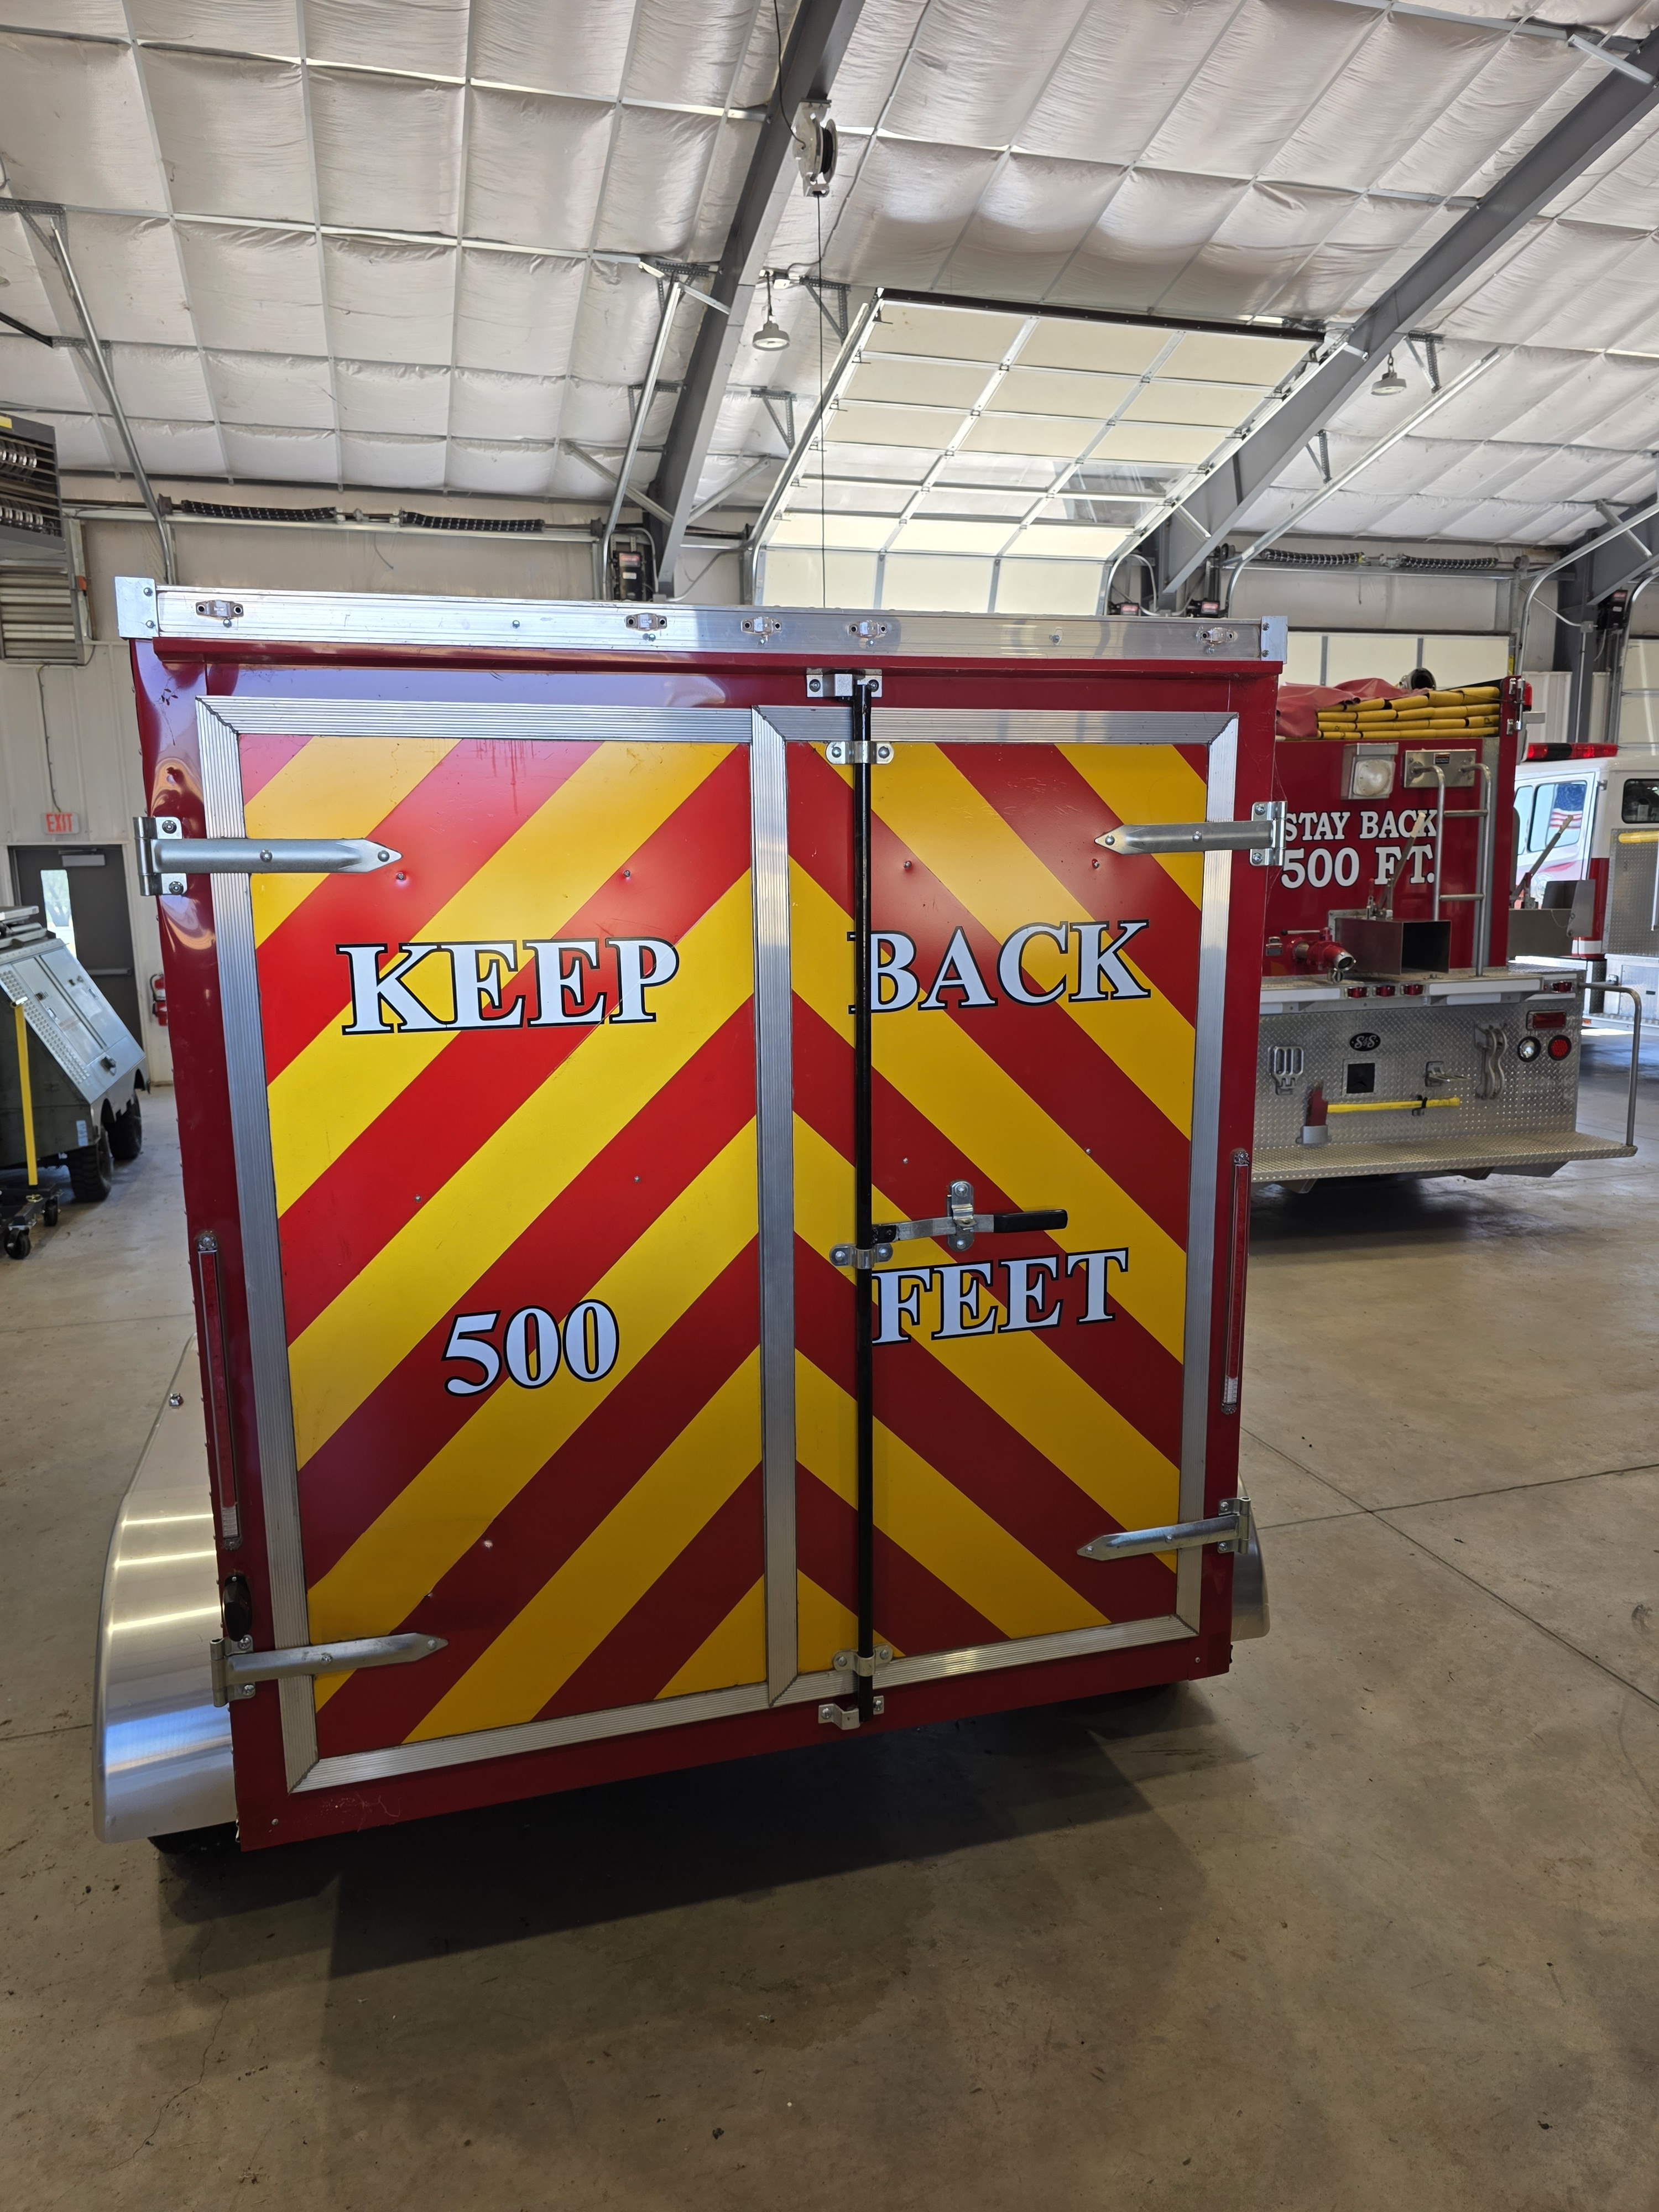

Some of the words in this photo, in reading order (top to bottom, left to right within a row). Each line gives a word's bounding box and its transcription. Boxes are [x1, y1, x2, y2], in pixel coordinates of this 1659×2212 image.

[45, 813, 72, 832] EXIT
[1286, 811, 1350, 842] STAY
[1359, 809, 1437, 839] BACK
[1281, 847, 1360, 889] 500
[1374, 843, 1435, 885] FT.
[336, 937, 680, 1035] KEEP
[847, 919, 1151, 1014] BACK
[441, 1298, 620, 1397] 500
[872, 1248, 1129, 1346] FEET
